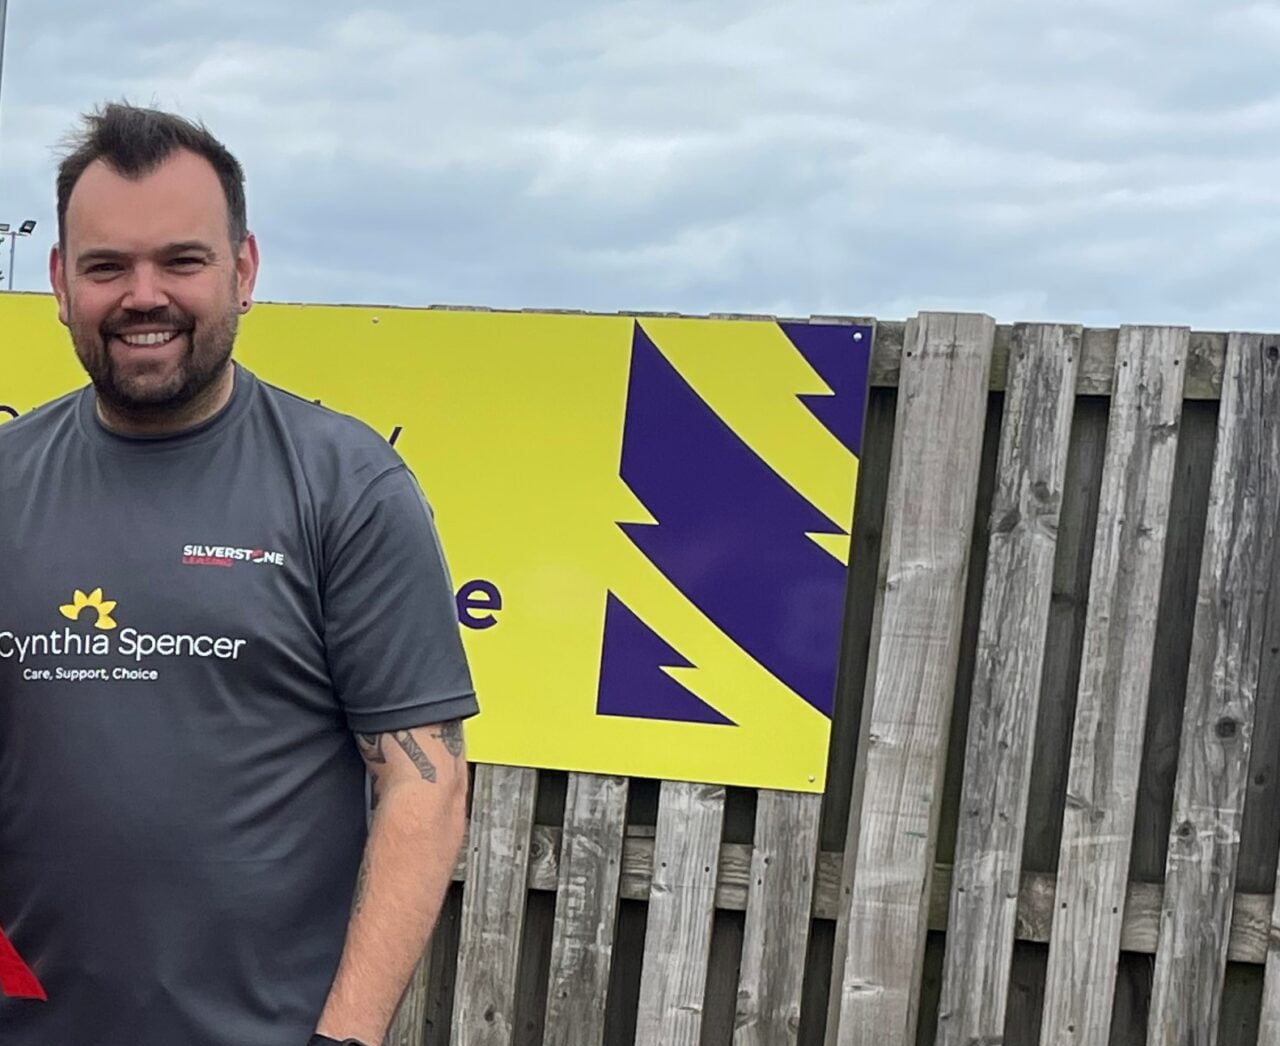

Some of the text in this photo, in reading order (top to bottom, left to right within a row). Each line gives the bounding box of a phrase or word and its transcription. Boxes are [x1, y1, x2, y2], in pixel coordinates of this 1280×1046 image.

[183, 545, 284, 566] SILVERSTONE
[118, 628, 246, 661] Spencer
[23, 667, 158, 682] Care, Support, Choice
